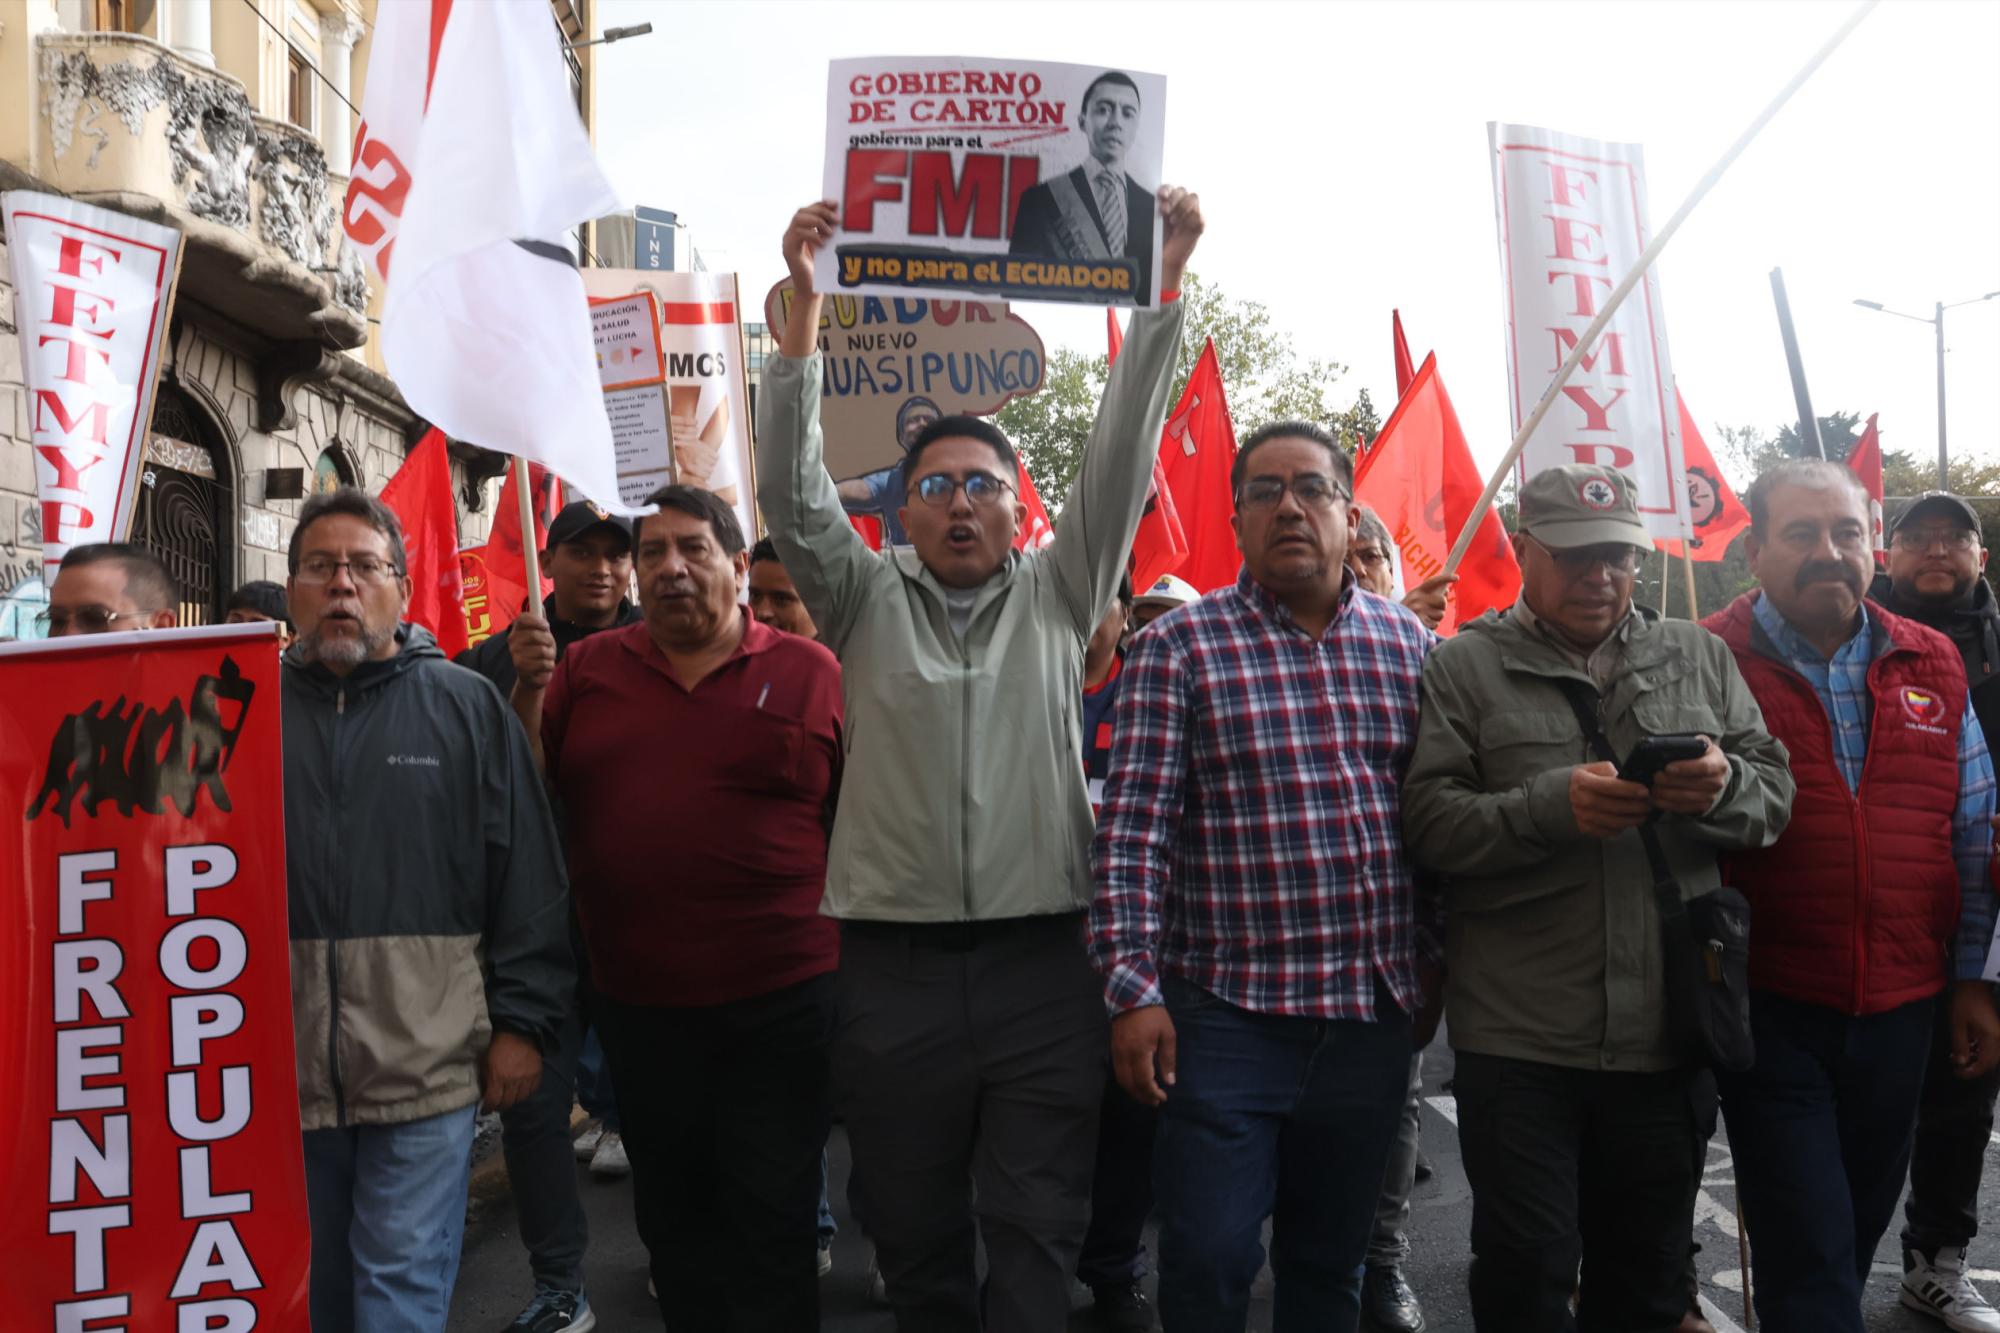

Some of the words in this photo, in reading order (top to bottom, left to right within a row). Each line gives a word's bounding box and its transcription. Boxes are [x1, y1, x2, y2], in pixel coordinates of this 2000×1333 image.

[849, 71, 1042, 97] GOBIERNO
[848, 99, 896, 124] DE
[849, 131, 924, 149] gobierna
[926, 133, 963, 150] para
[967, 135, 983, 149] el
[841, 148, 1040, 240] FMI
[844, 256, 861, 282] y
[867, 257, 901, 278] no
[906, 259, 968, 281] para
[973, 261, 999, 282] el
[1006, 262, 1130, 290] ECUADOR
[601, 319, 630, 331] SALUD
[607, 331, 637, 343] LUCHA
[847, 331, 917, 351] NUEVO
[32, 231, 121, 546] FETMYP
